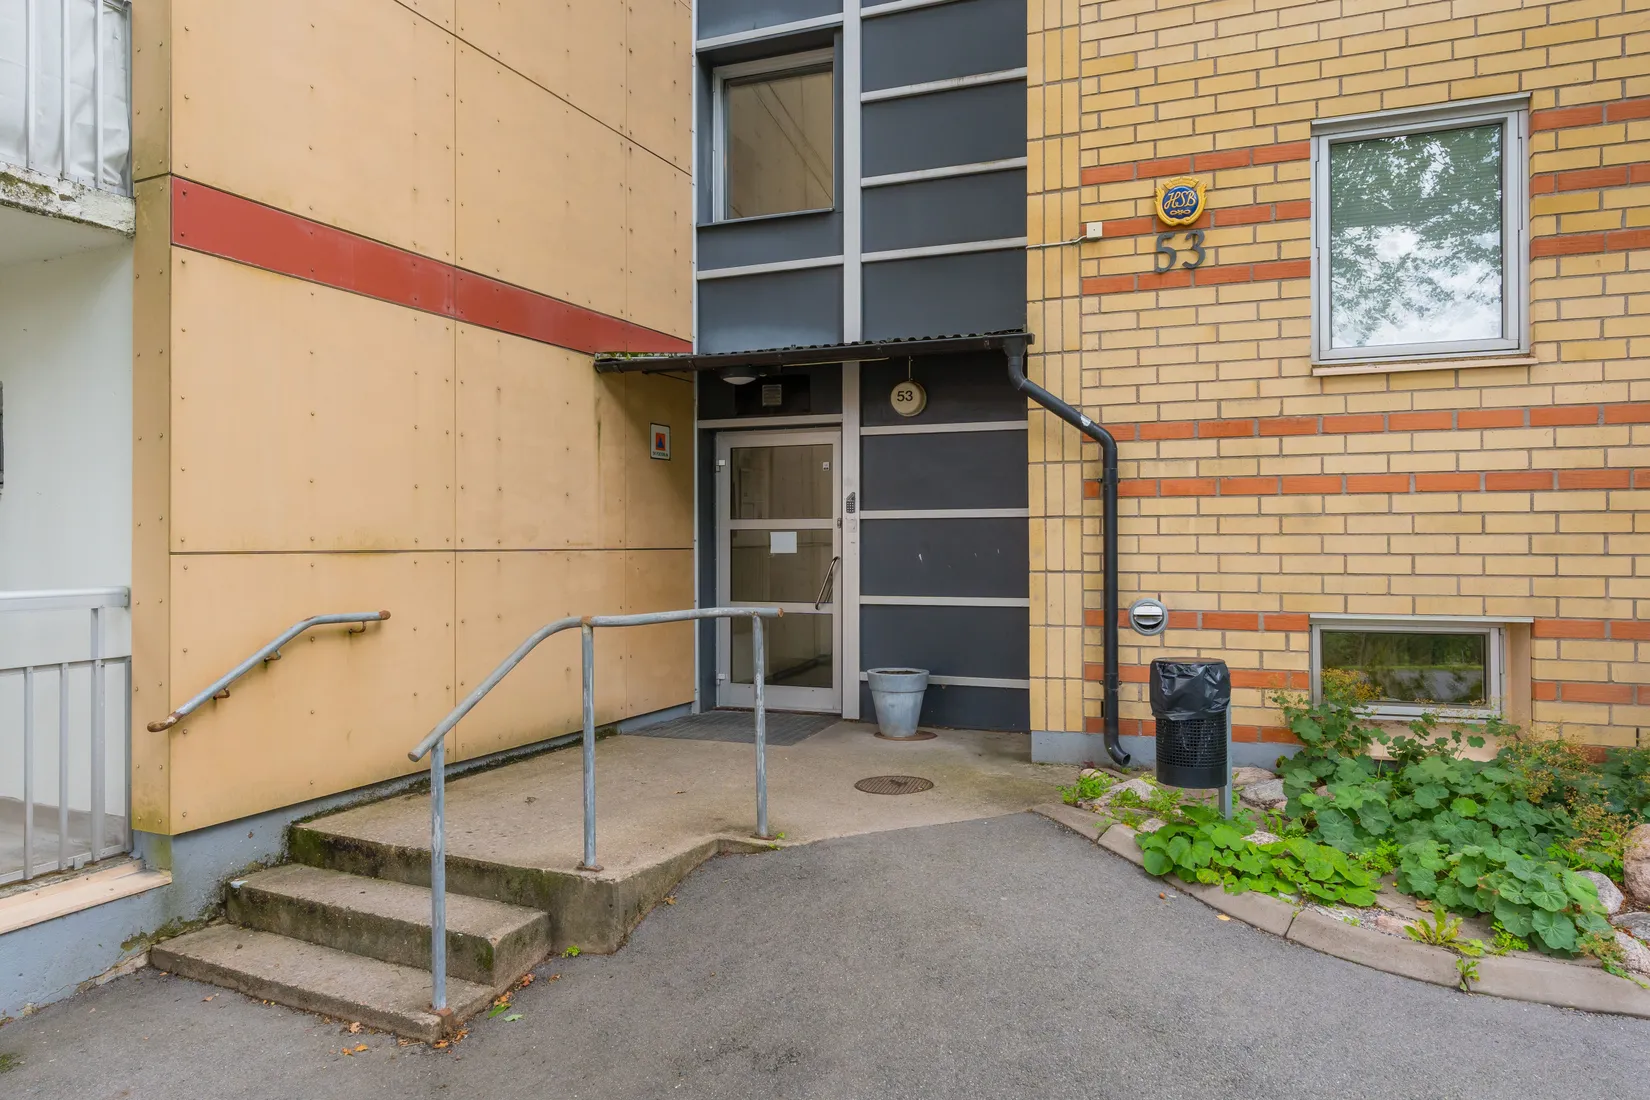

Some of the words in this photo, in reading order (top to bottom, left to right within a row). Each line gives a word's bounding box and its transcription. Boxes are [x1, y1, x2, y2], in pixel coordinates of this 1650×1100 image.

[1163, 190, 1196, 209] HSB
[1154, 229, 1206, 273] 53
[896, 390, 914, 402] 53
